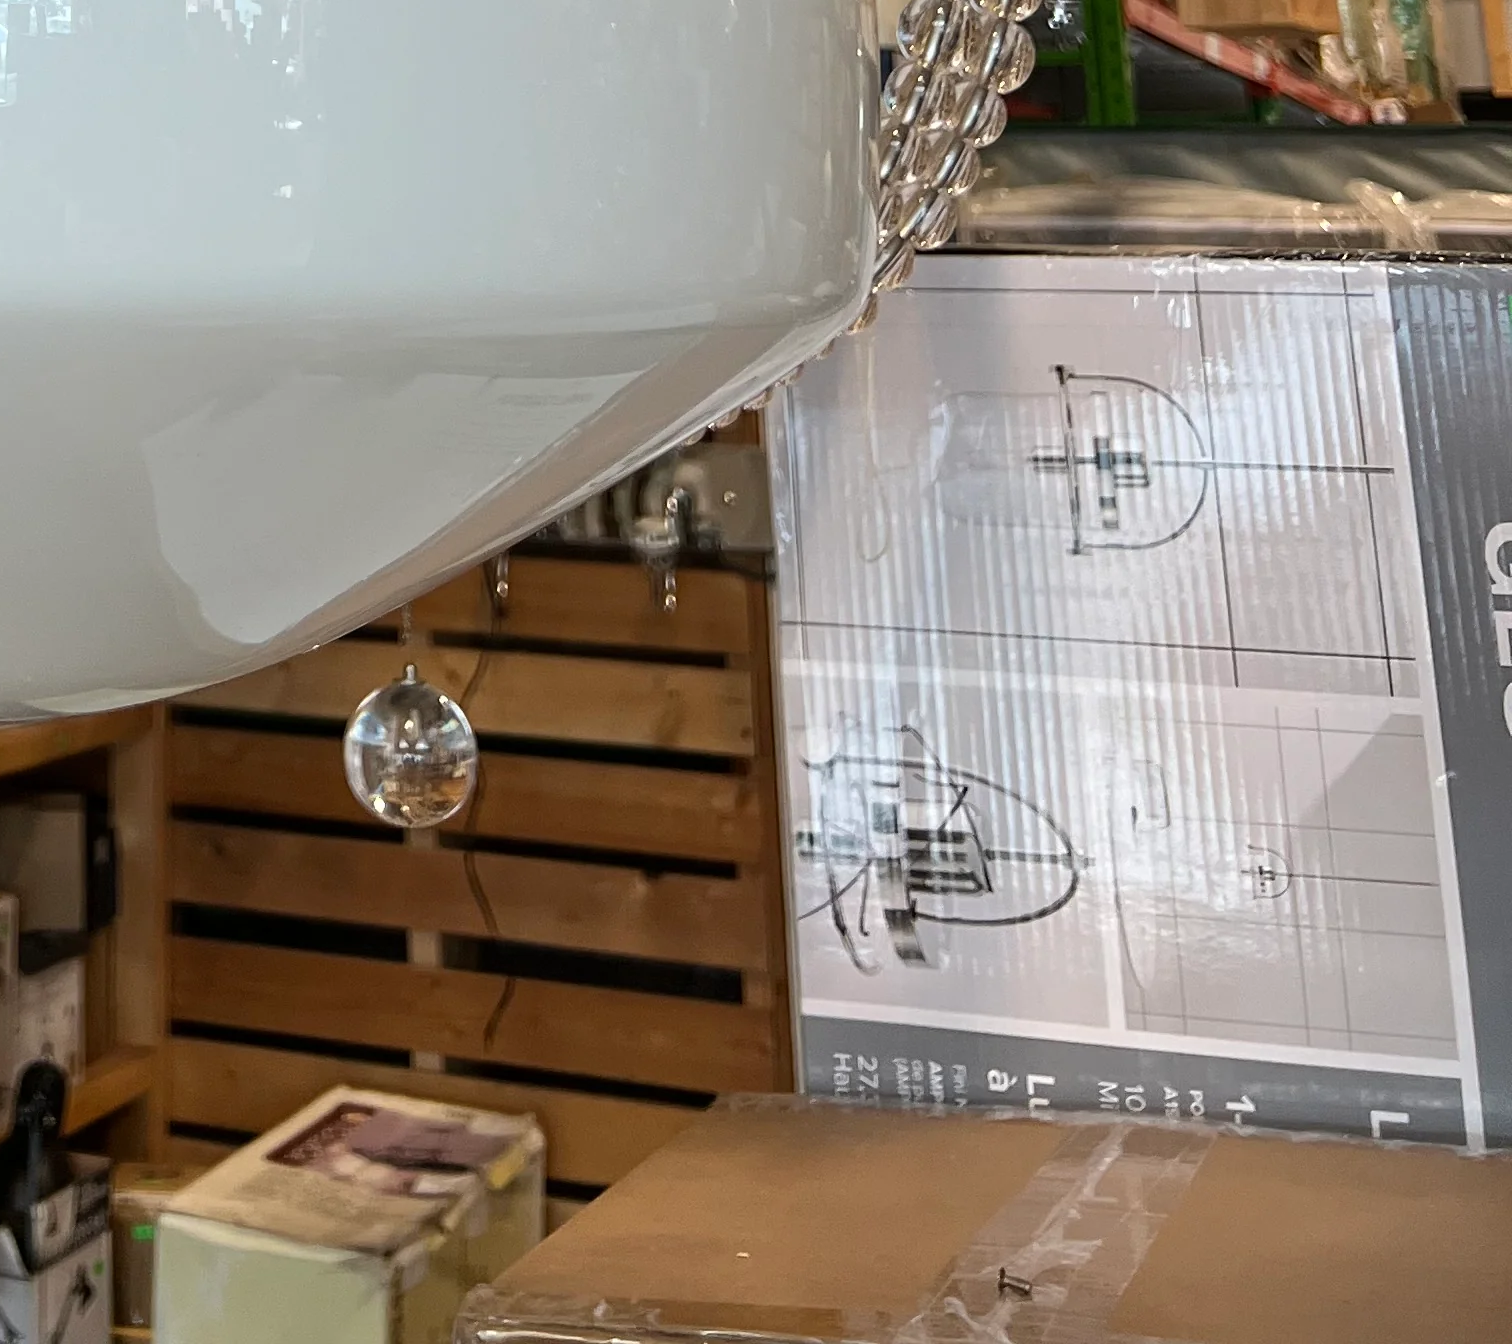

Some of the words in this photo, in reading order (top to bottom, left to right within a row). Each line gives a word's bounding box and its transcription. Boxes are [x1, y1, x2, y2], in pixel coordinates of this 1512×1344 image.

[1026, 1074, 1056, 1118] Lu
[1226, 1094, 1257, 1125] 1-
[1370, 1109, 1410, 1139] L
